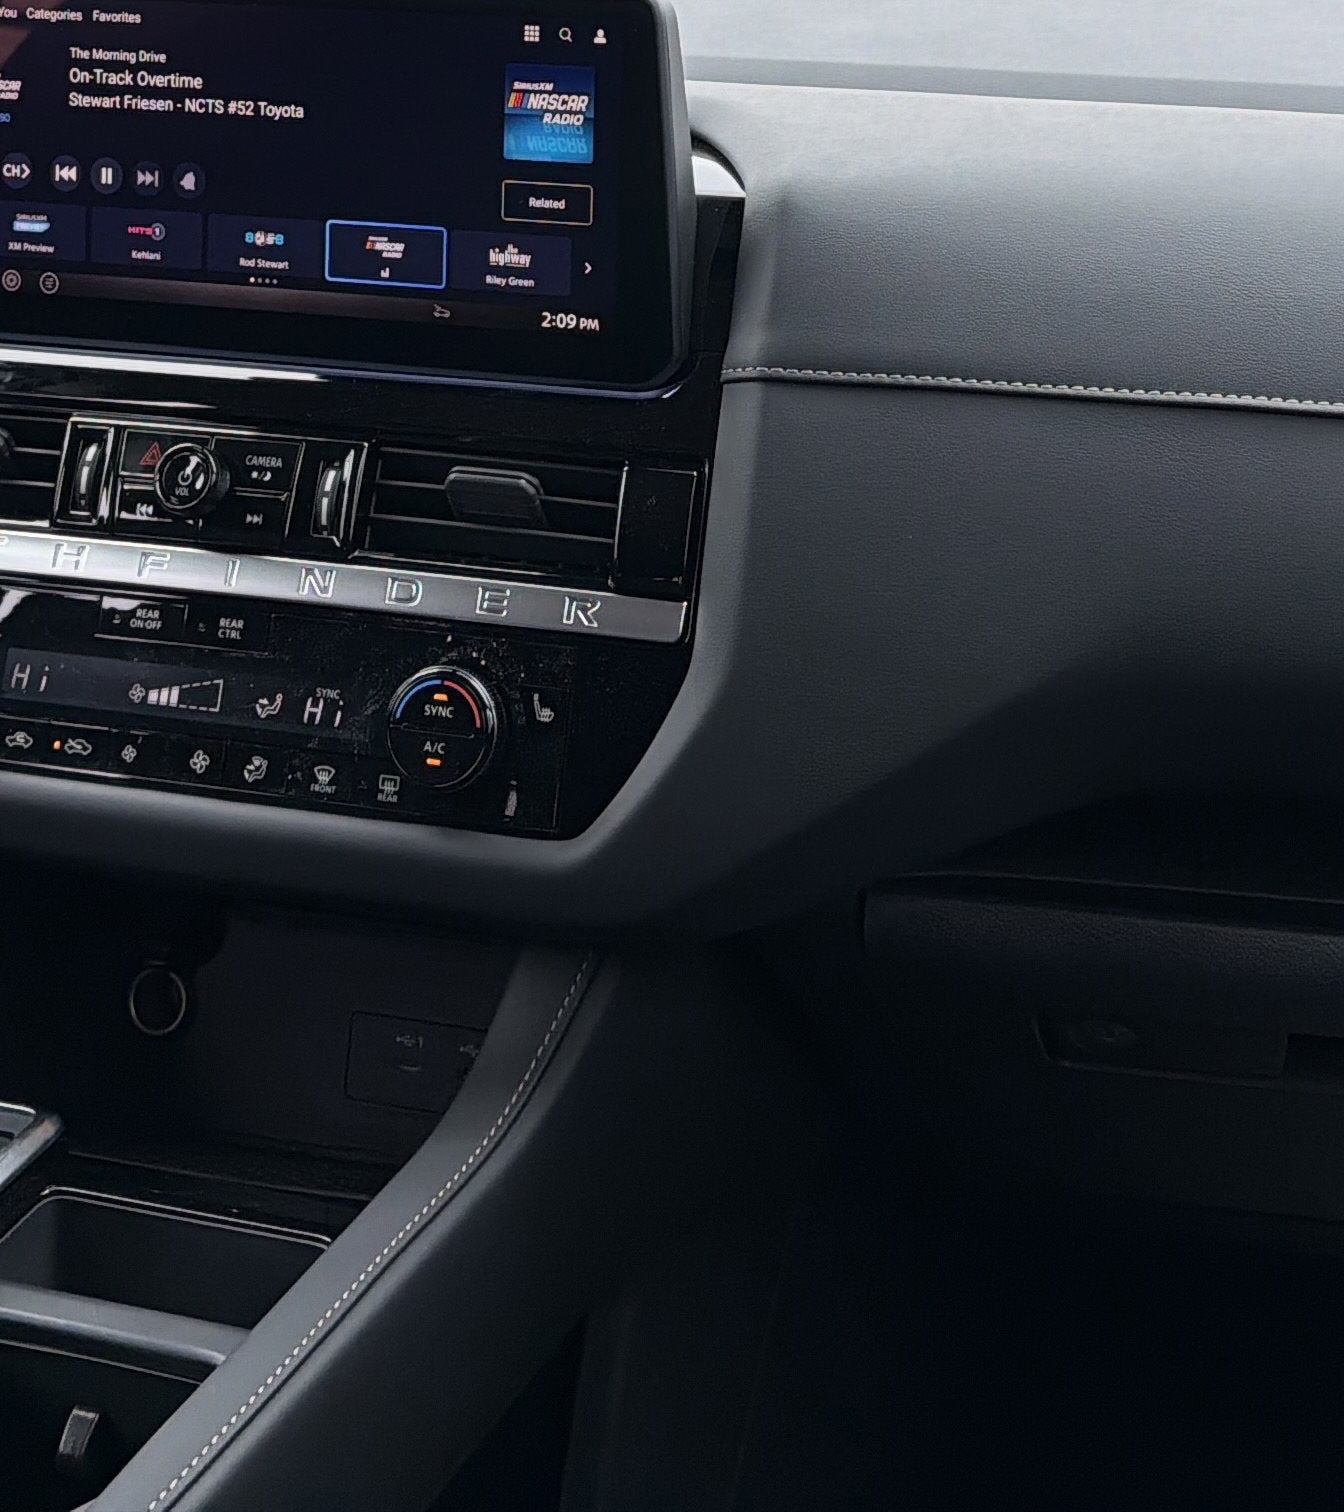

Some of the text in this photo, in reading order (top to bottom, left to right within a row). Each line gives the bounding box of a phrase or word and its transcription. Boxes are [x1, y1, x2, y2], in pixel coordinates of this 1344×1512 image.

[26, 7, 82, 22] Categories
[92, 10, 141, 24] Favorites
[70, 47, 167, 64] The Morning Drive
[69, 68, 203, 89] On-Track Overtime
[69, 93, 121, 109] Stewart
[123, 95, 173, 112] Friesen
[184, 99, 224, 114] NCTS
[227, 101, 255, 116] #52
[258, 102, 305, 120] Toyota
[527, 93, 589, 111] NASCAR
[543, 113, 584, 125] RADIO
[529, 197, 566, 209] Related
[8, 242, 55, 254] XM Preview
[239, 257, 289, 269] Rod Stewart
[489, 248, 531, 267] highway
[486, 275, 534, 287] Riley Green
[541, 312, 599, 331] 2:09 PM
[246, 455, 282, 468] CAMERA
[175, 487, 189, 497] VOL
[136, 608, 160, 620] REAR
[219, 618, 244, 629] REAR
[218, 629, 242, 640] CTRL
[11, 662, 50, 692] Hi
[316, 687, 340, 700] SYNC
[303, 696, 344, 728] Hi
[424, 704, 454, 718] SYNC
[423, 741, 445, 754] A/C
[310, 784, 336, 794] FRONT
[377, 793, 398, 802] REAR
